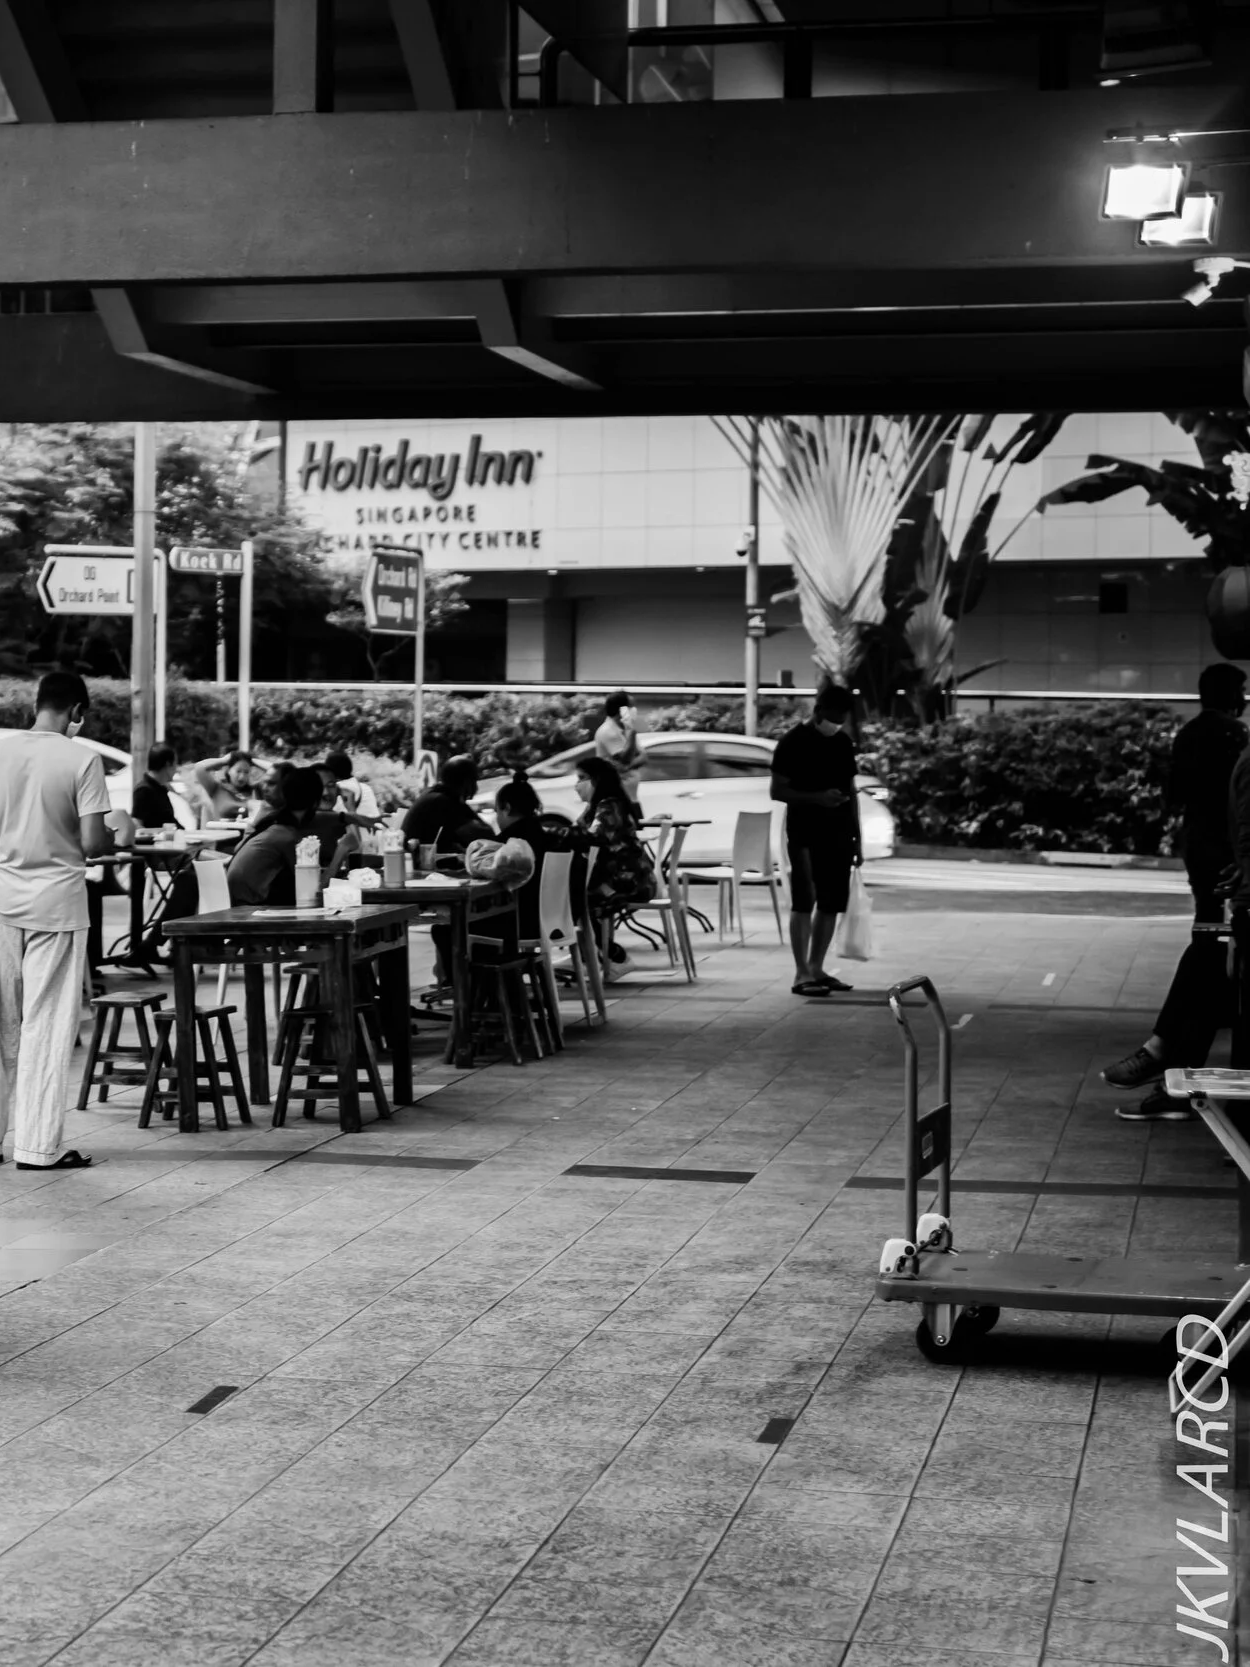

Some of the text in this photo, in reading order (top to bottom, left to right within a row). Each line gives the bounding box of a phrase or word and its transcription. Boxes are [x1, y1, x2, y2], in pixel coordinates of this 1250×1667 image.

[299, 434, 537, 501] Holiday Inn
[356, 504, 477, 525] SINGAPORE
[403, 532, 450, 551] CITY
[458, 530, 542, 550] CENTRE
[223, 553, 242, 570] Rd
[59, 587, 93, 603] Orchard
